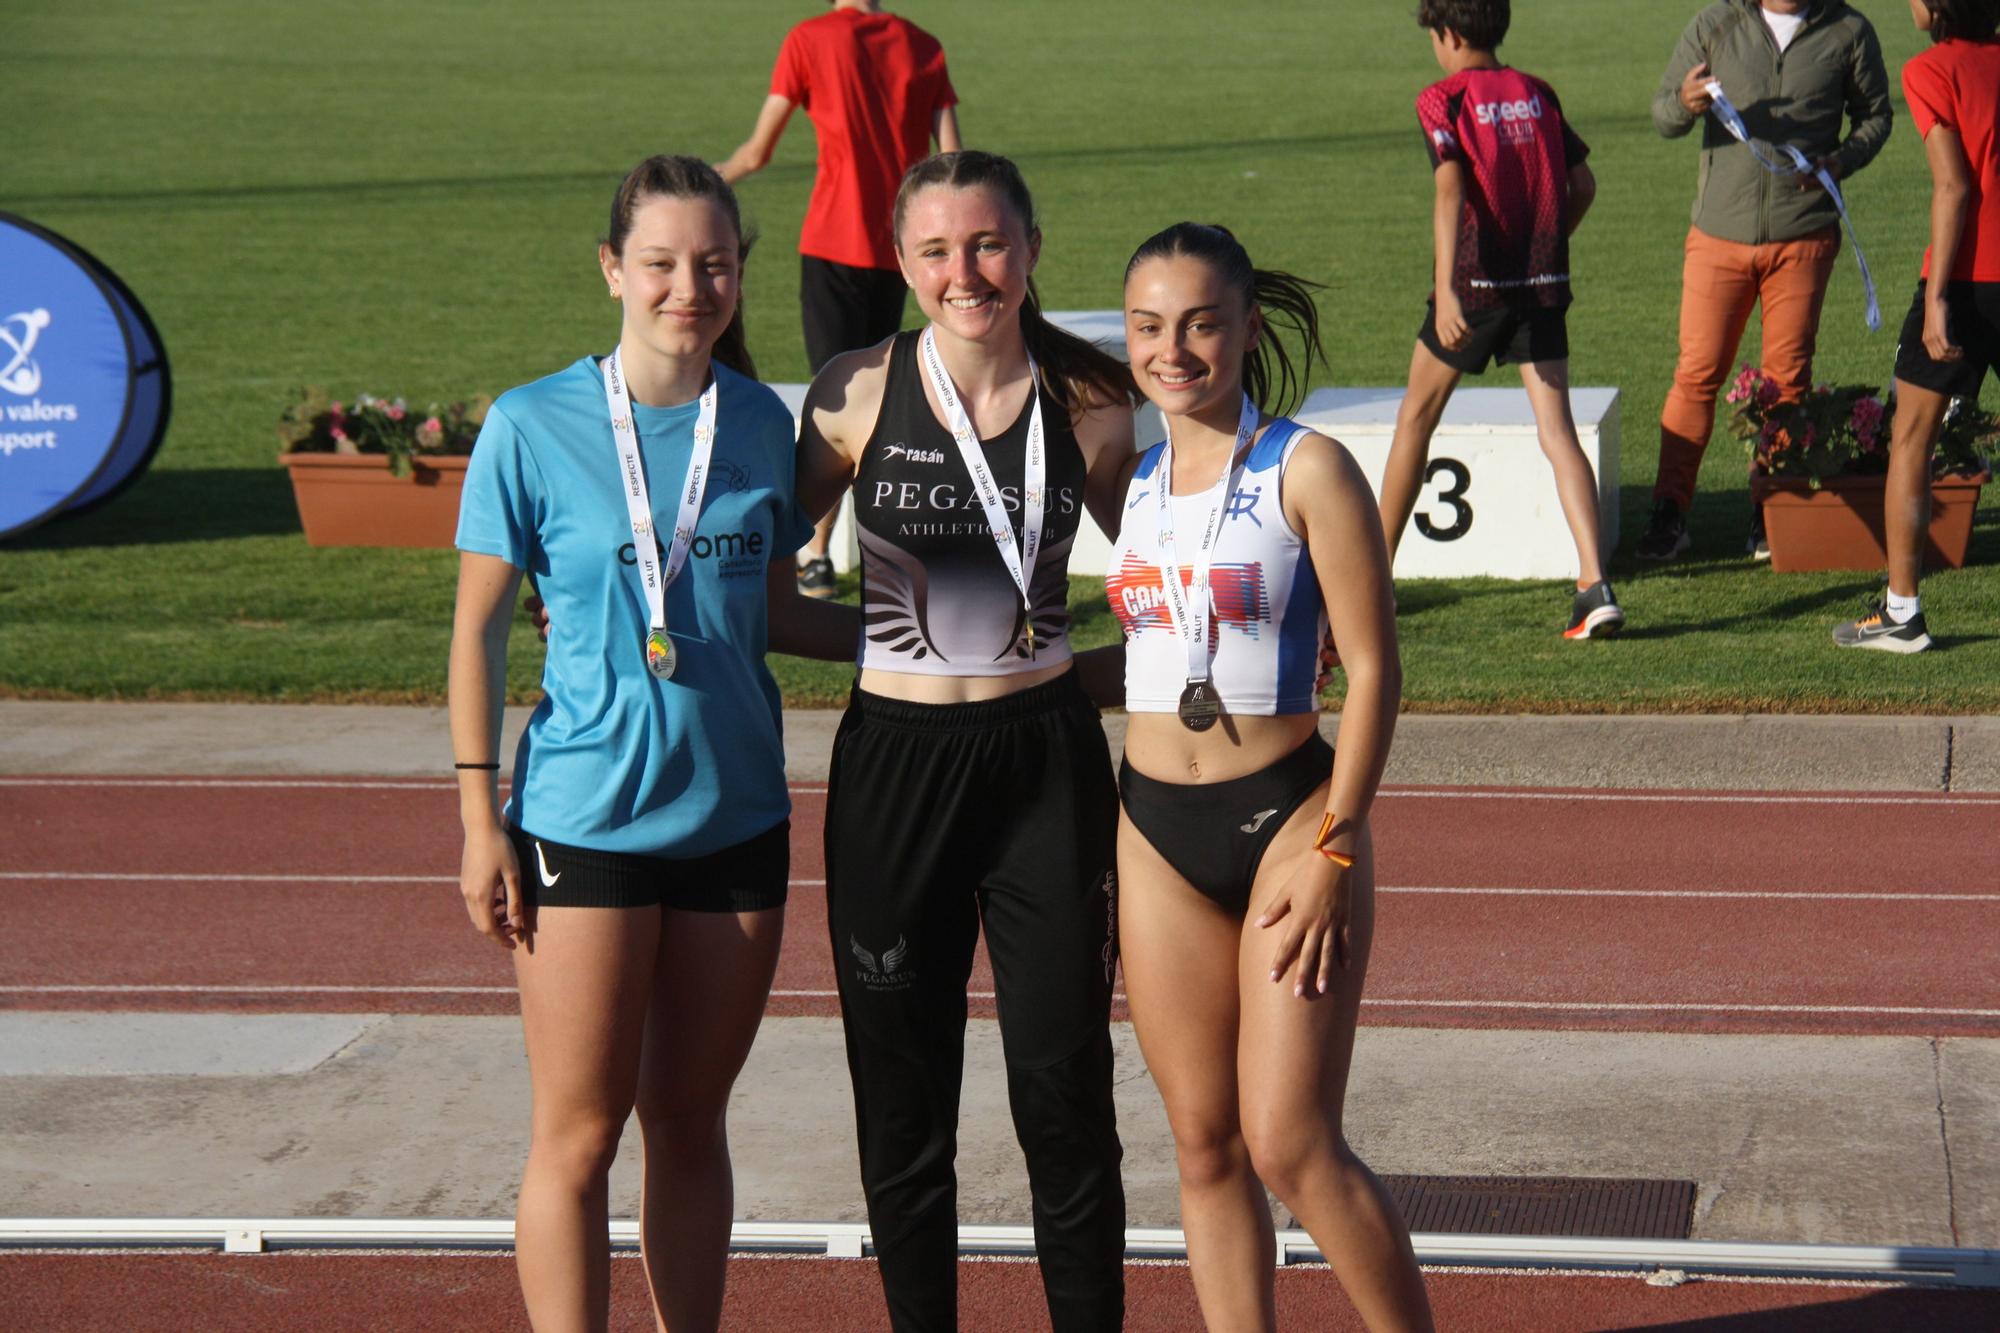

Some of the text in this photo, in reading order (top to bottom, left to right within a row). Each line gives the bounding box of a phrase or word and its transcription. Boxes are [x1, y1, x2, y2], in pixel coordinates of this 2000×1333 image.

[1475, 94, 1542, 127] speed
[7, 399, 78, 422] valors
[906, 448, 944, 464] rasán
[625, 453, 640, 497] RESPECTE
[687, 464, 702, 506] RESPECTE
[973, 463, 996, 506] RESPECTE
[1414, 457, 1474, 542] 3
[1028, 530, 1037, 558] SALUT
[1202, 506, 1217, 550] RESPECTE
[617, 531, 763, 566] come
[645, 560, 656, 588] SALUT
[1194, 614, 1202, 644] SALUT
